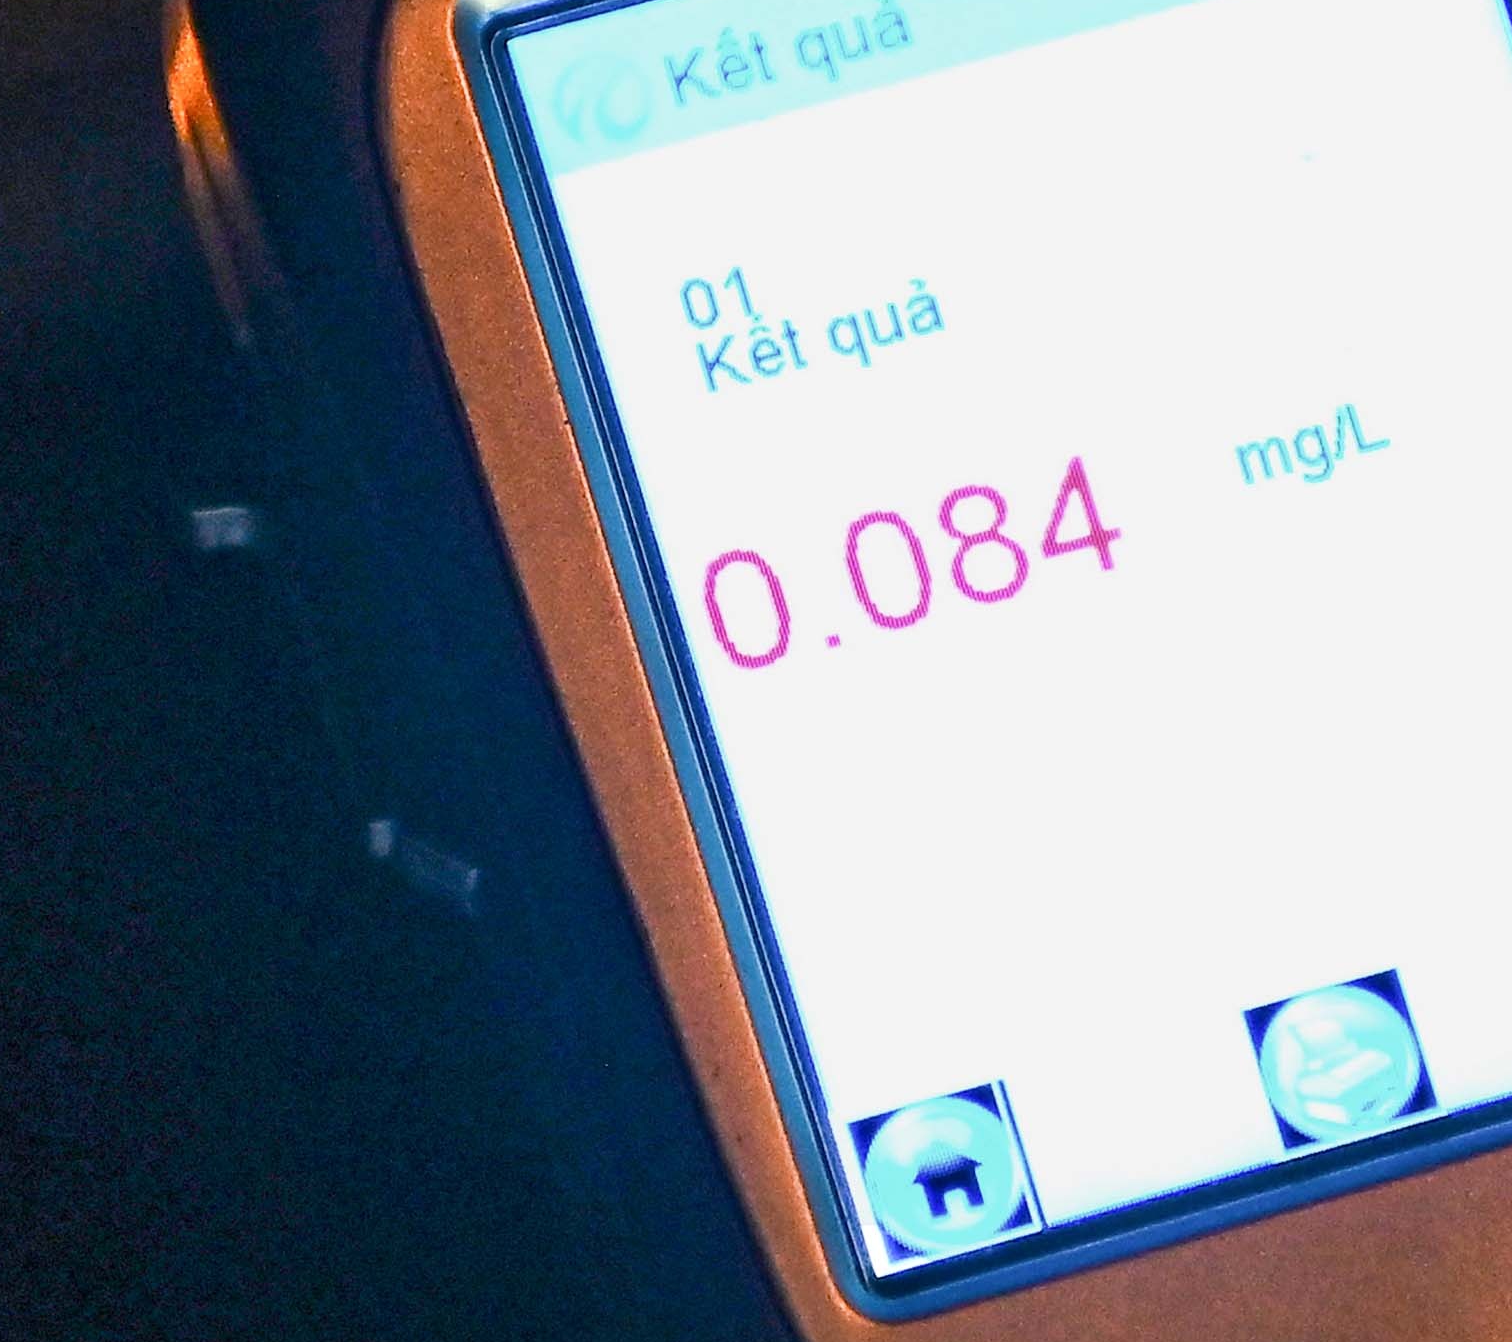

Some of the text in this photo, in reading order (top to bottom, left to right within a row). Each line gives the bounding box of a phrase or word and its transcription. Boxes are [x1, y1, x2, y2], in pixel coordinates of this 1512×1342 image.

[663, 26, 778, 107] Kết
[679, 265, 754, 330] 01
[695, 276, 946, 393] Kết quả
[703, 402, 1391, 670] 0.084 mg/L
